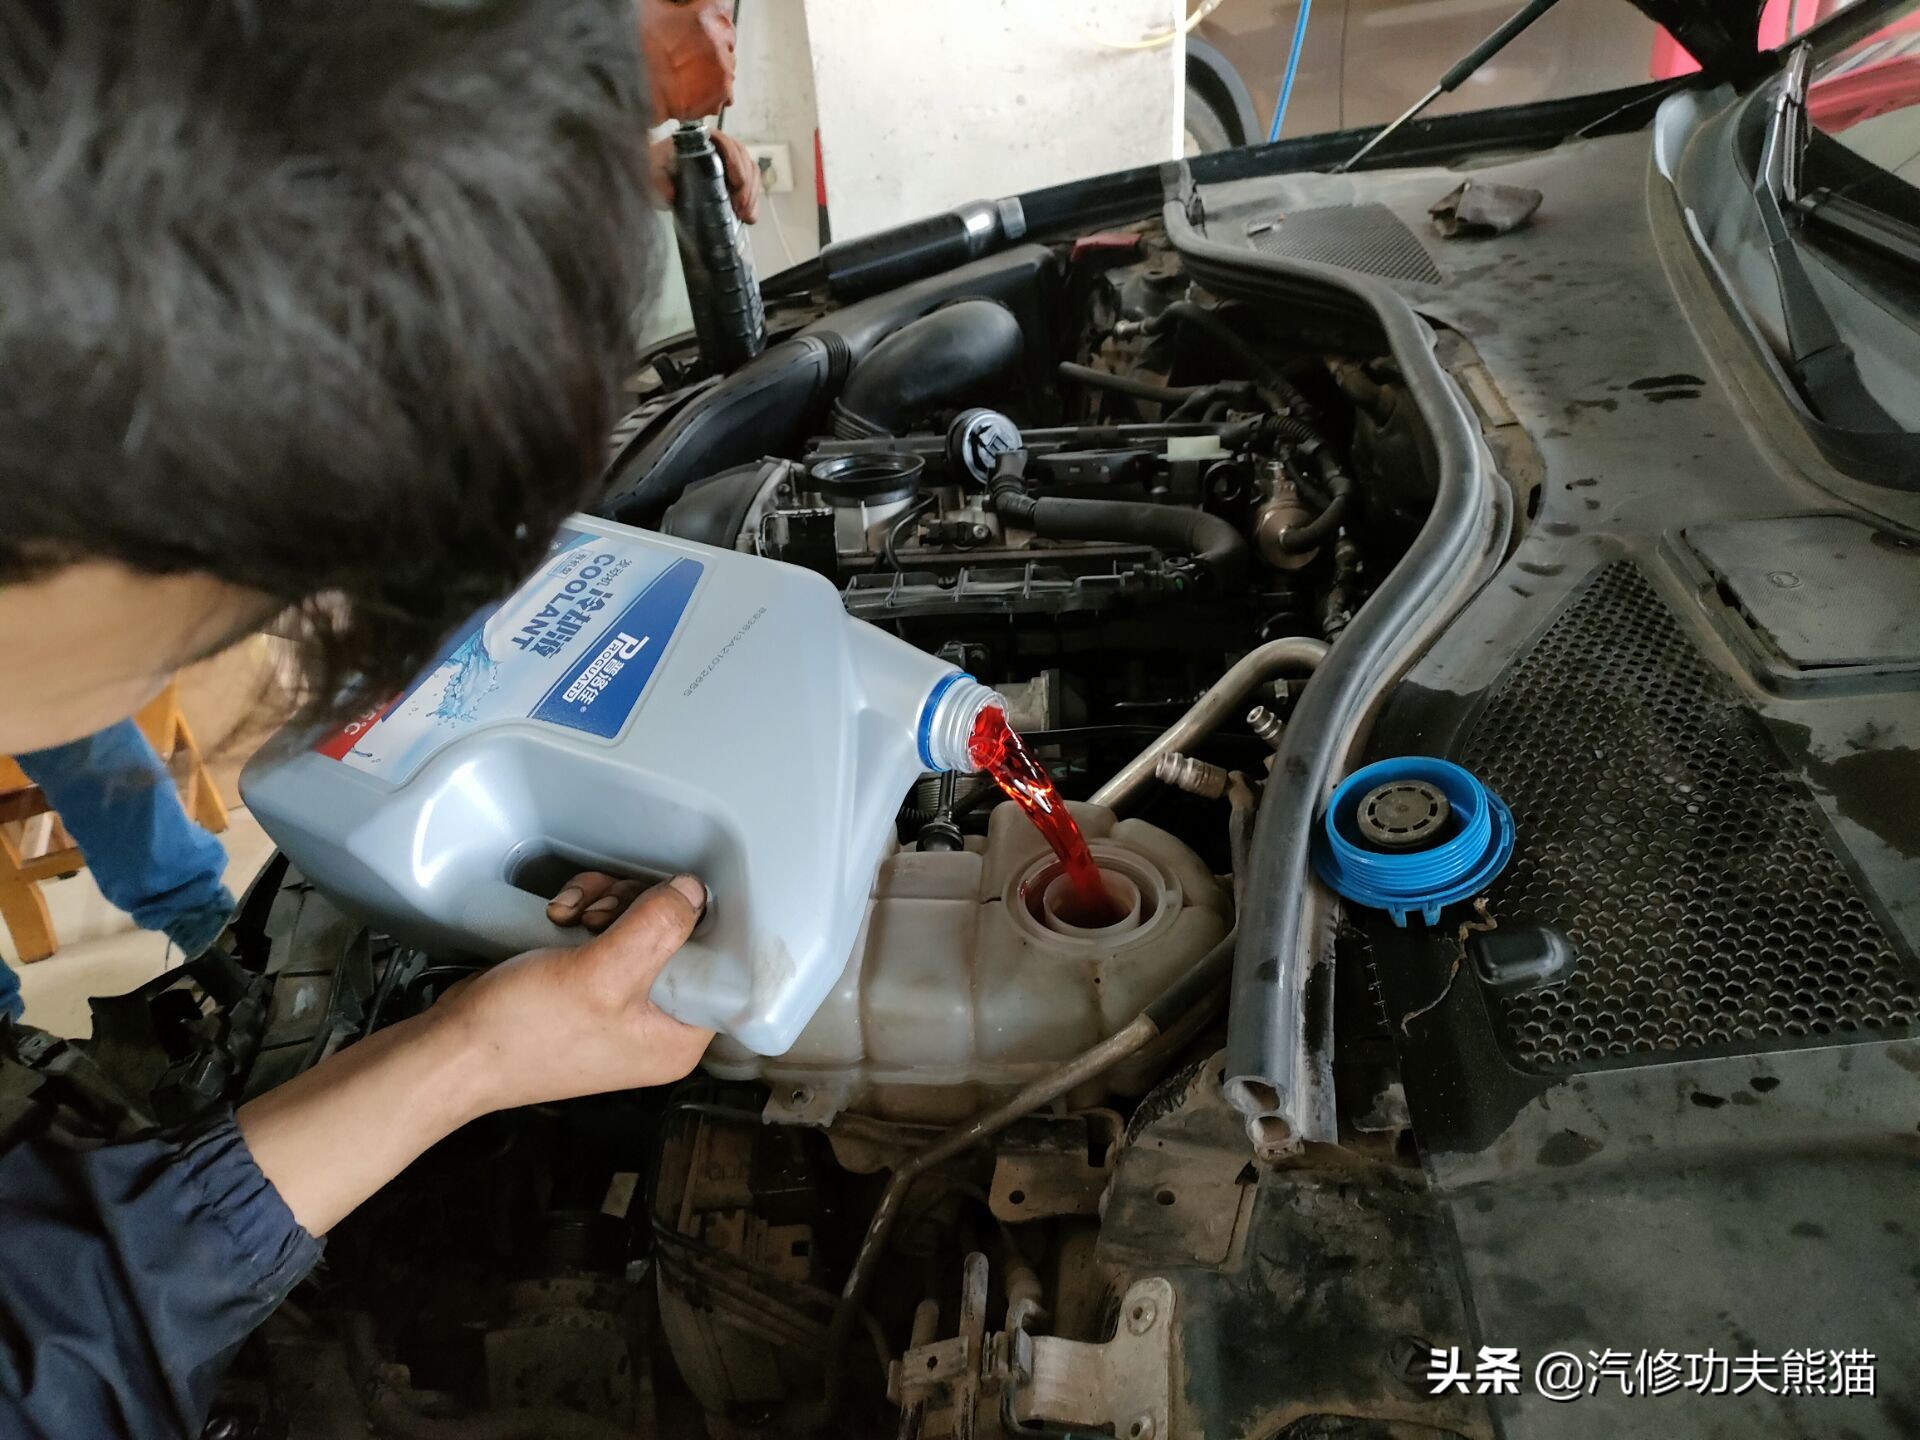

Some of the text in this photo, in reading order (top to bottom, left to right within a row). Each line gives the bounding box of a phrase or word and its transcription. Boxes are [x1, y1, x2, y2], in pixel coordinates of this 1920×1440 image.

[511, 554, 616, 651] COOLANT
[531, 587, 614, 659] 冷却液
[576, 659, 625, 705] 普洛佳
